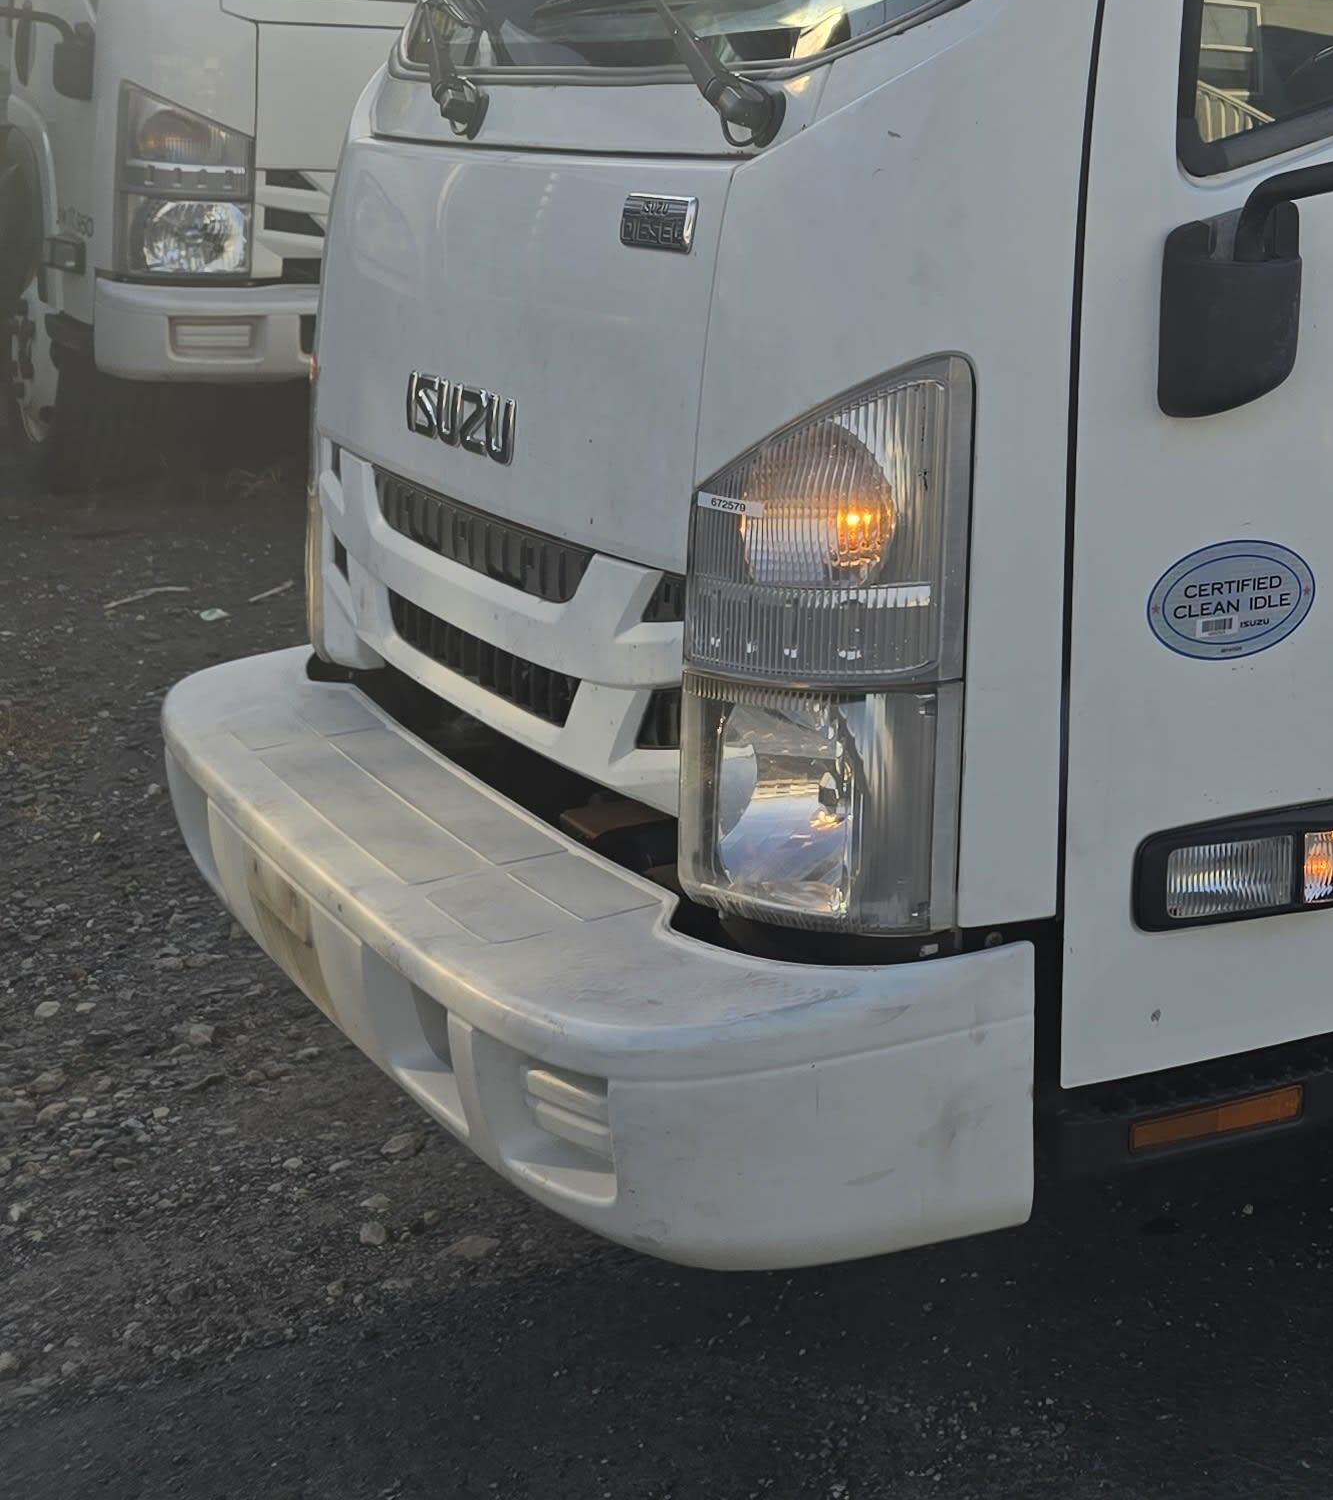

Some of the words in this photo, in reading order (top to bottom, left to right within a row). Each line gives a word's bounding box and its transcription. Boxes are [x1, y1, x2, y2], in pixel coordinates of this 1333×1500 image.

[406, 369, 519, 467] ISUZU
[711, 497, 746, 512] 672579
[1184, 575, 1282, 599] CERTIFIED
[1173, 598, 1240, 620] CLEAN
[1249, 592, 1292, 610] IDLE
[1240, 618, 1270, 628] ISUZU
